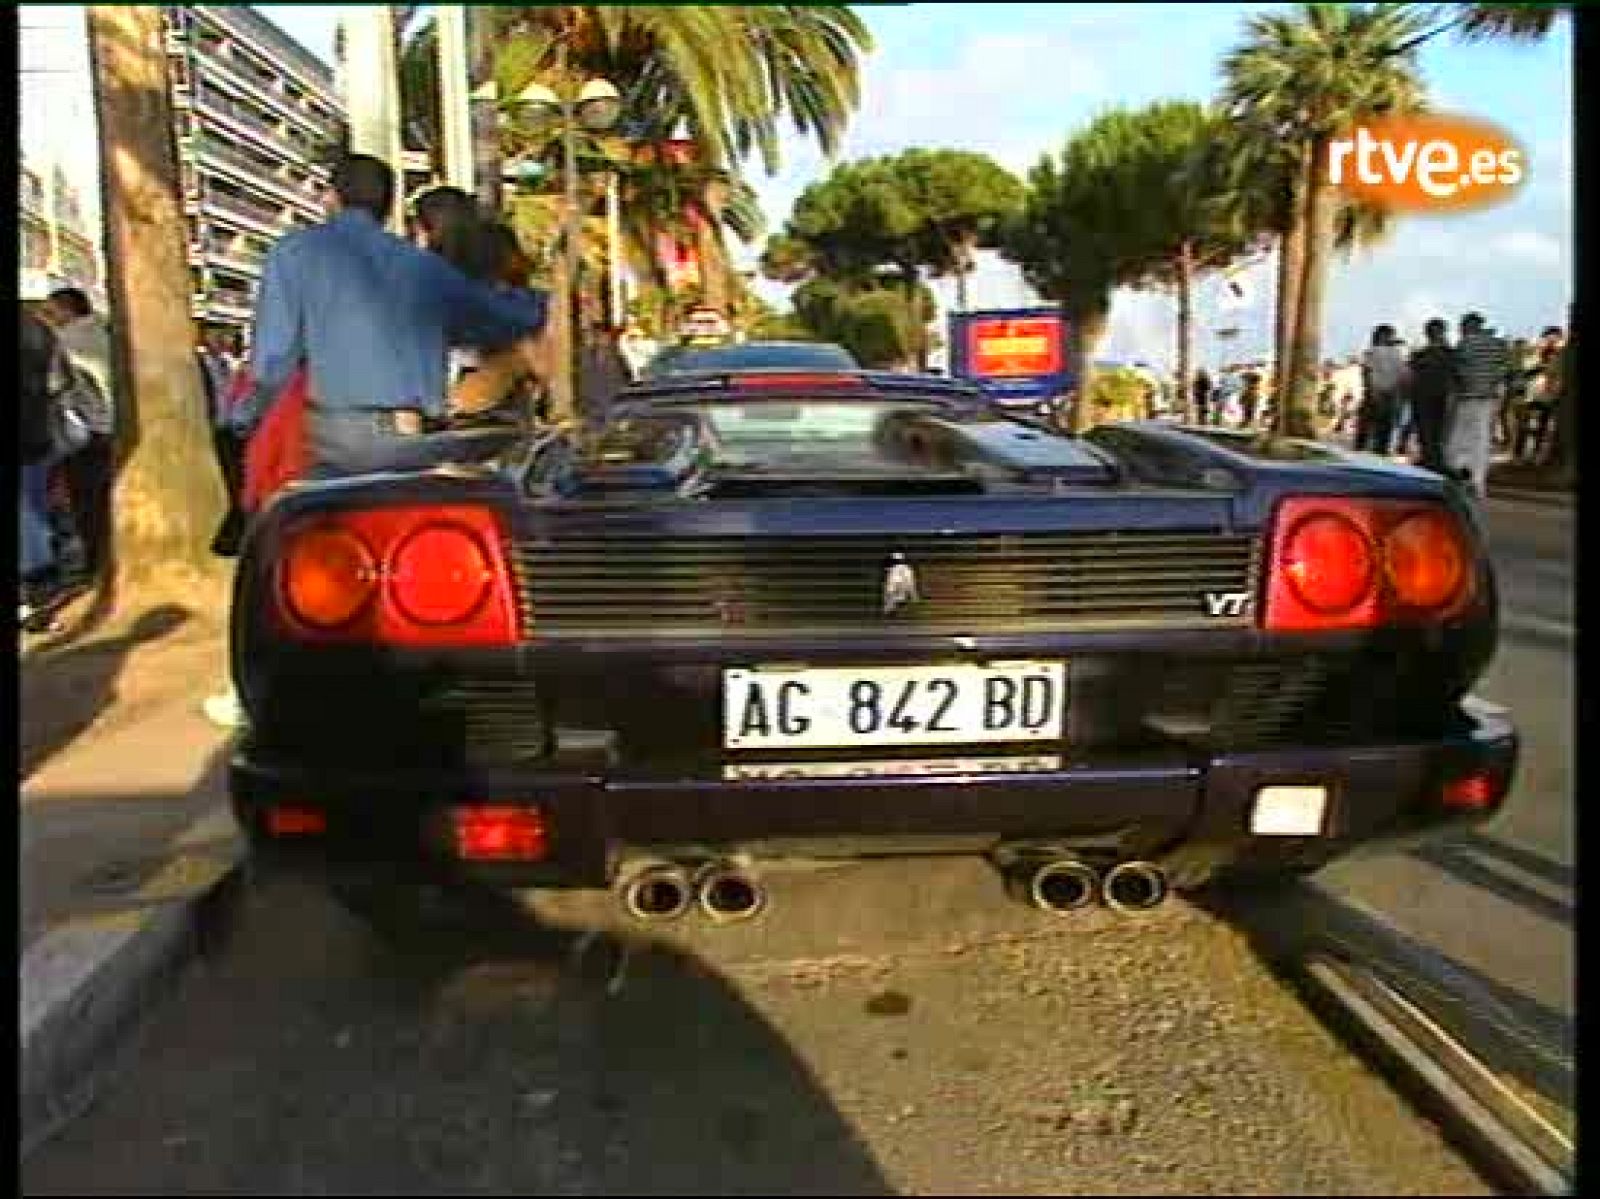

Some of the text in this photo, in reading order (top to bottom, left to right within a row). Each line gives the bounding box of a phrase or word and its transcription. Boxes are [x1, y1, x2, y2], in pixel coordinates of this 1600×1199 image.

[1206, 593, 1249, 615] VT
[738, 674, 1053, 737] AG 842 BD
